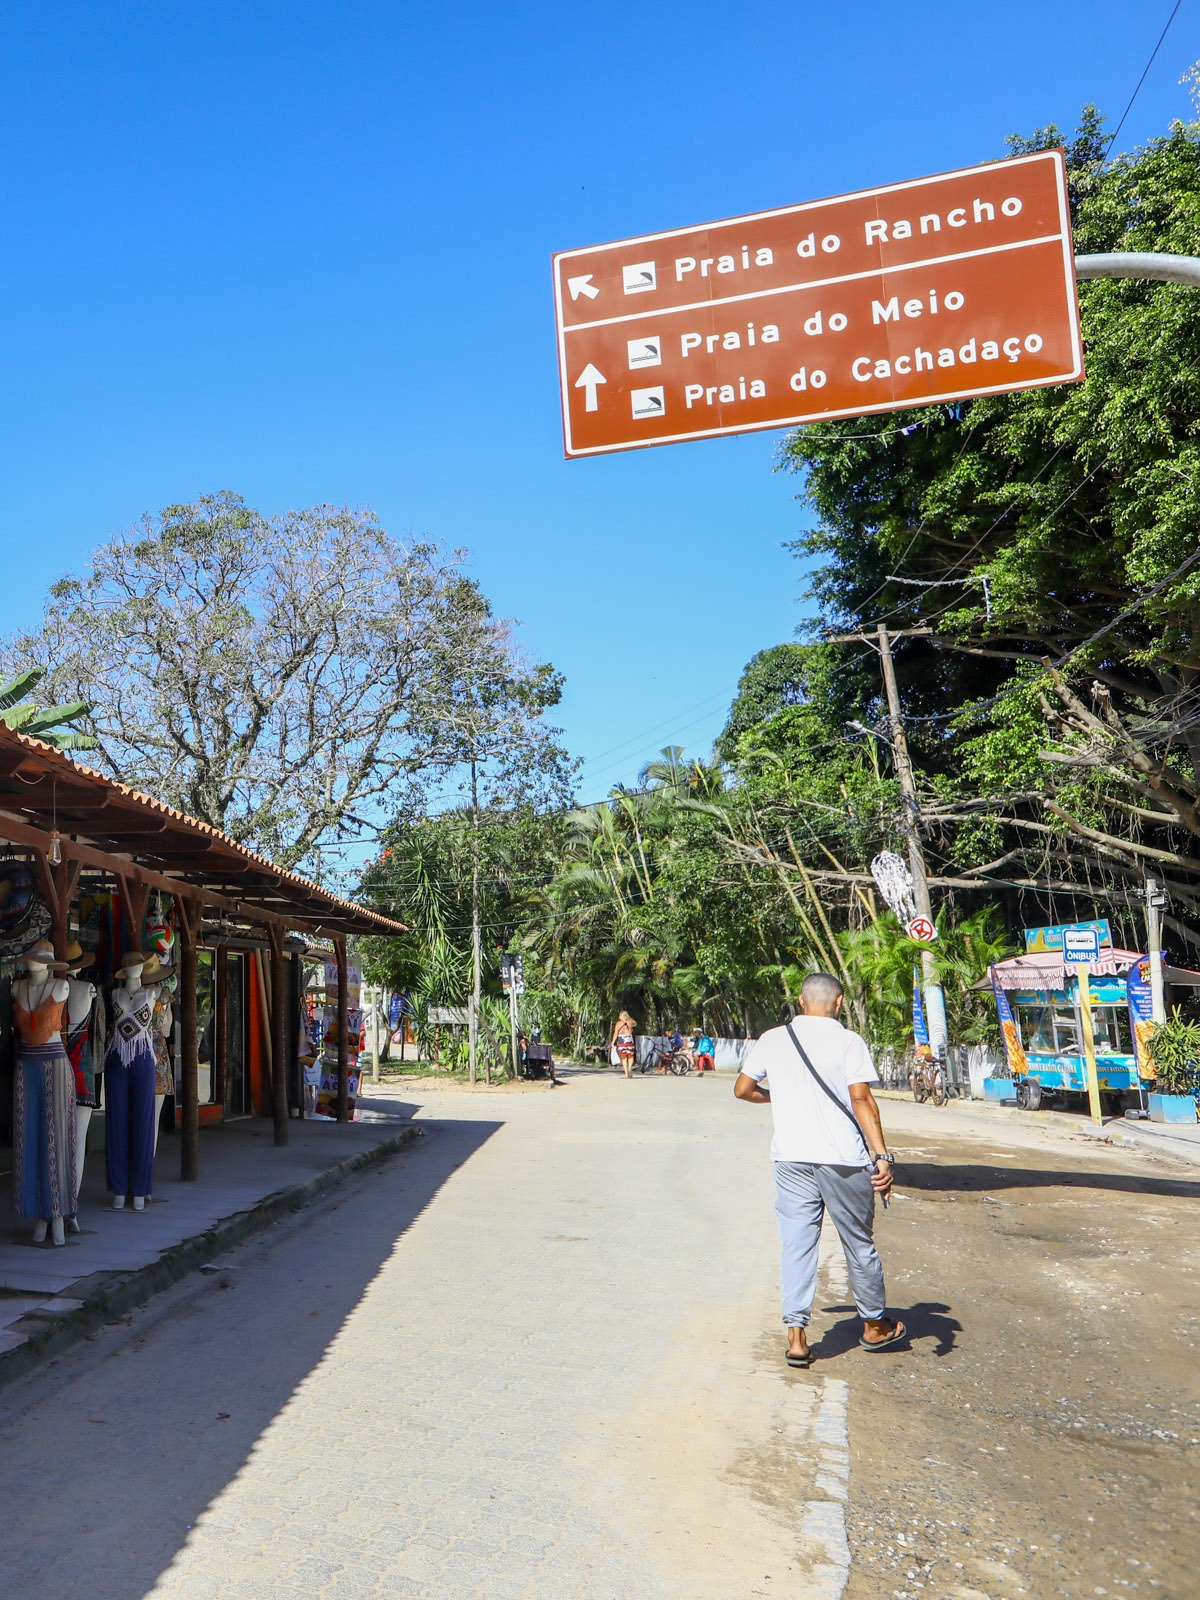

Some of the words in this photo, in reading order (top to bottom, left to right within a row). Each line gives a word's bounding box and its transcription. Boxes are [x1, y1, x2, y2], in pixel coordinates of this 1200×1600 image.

[674, 244, 774, 282] Praia
[796, 232, 841, 258] do
[864, 196, 1023, 246] Rancho
[680, 322, 780, 357] Praia
[803, 310, 848, 336] do
[871, 289, 965, 325] Meio
[684, 376, 766, 409] Praia
[789, 367, 827, 392] do
[851, 333, 1044, 383] Cachadaço
[1067, 951, 1097, 961] ÔNIBUS
